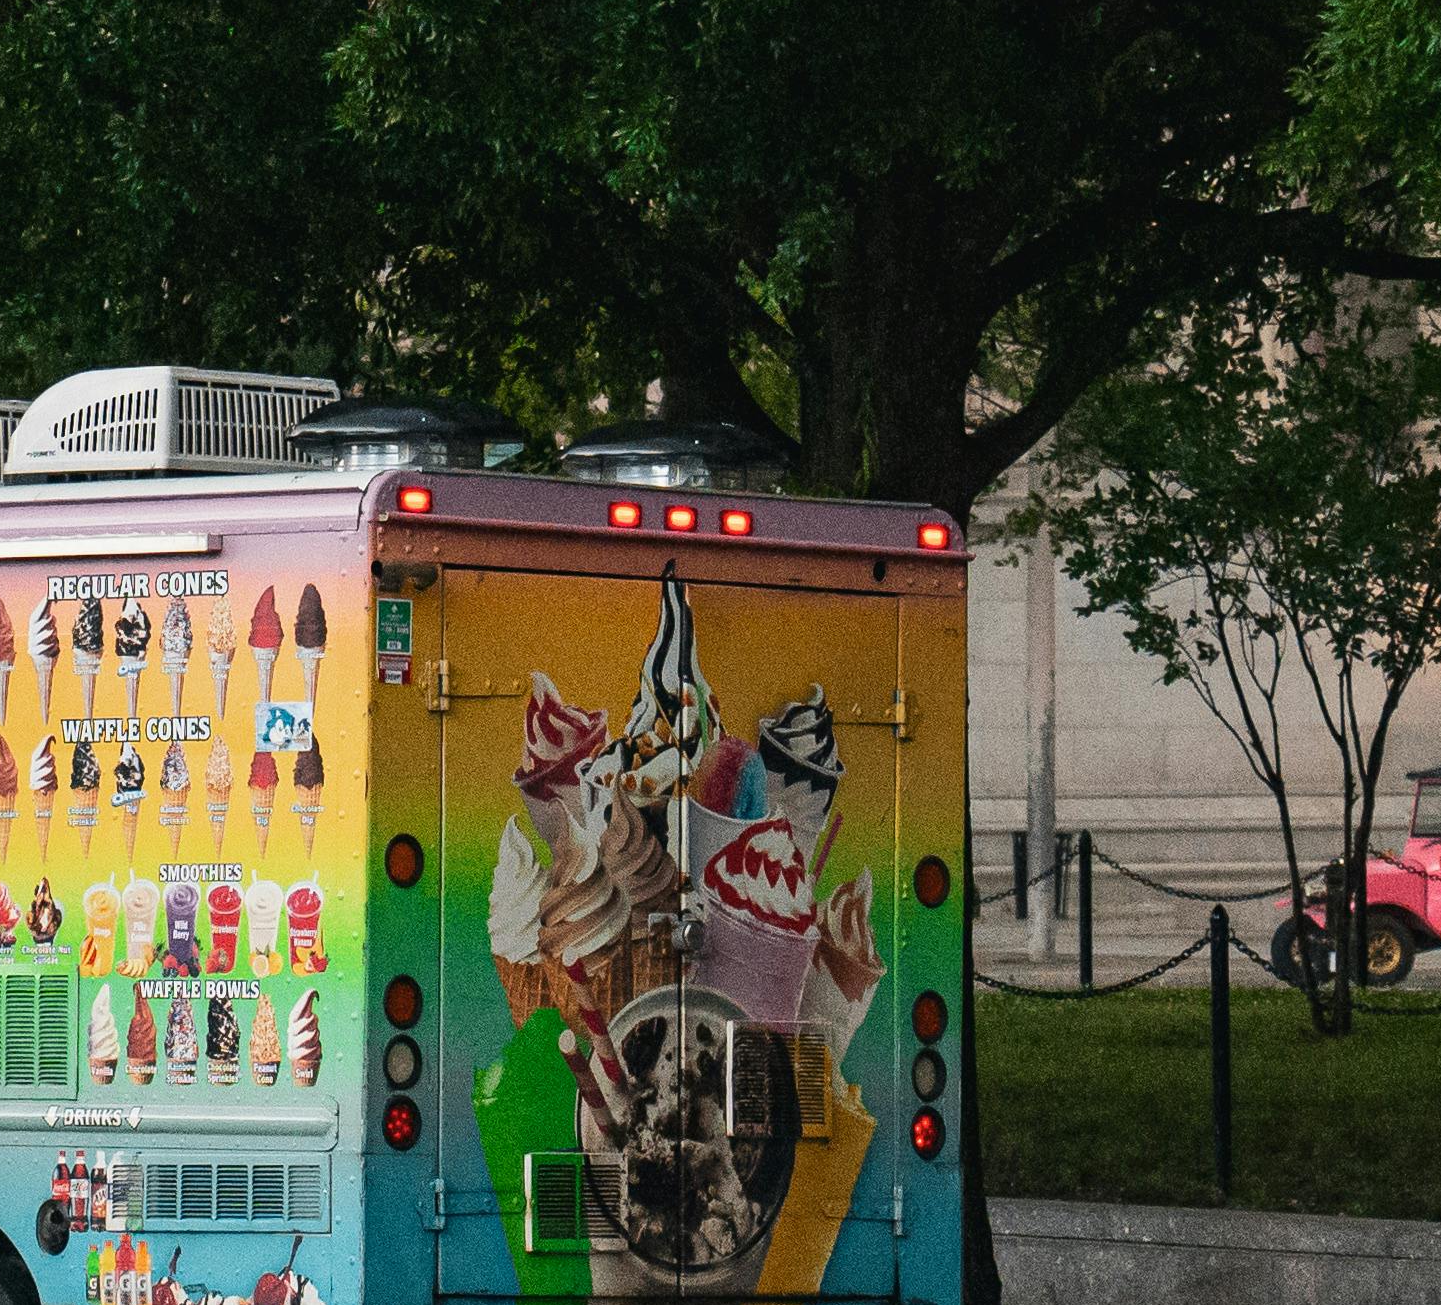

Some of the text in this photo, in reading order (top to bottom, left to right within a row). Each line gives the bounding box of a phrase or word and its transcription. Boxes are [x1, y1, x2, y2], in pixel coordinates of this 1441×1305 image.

[47, 570, 229, 600] REGULAR CONES
[61, 716, 212, 743] WAFFLE CONES
[290, 803, 326, 813] Chocolate
[256, 816, 268, 826] Dip
[301, 815, 315, 825] Dip
[159, 863, 243, 882] SMOOTHIES
[174, 920, 189, 930] Wild
[172, 929, 190, 941] Berry
[22, 945, 71, 954] Chocolate Nut
[139, 979, 260, 999] WAFFLE BOWLS
[90, 1065, 114, 1077] Vanilla
[124, 1063, 157, 1074] Chocolate
[206, 1062, 240, 1073] Chocolate
[253, 1063, 277, 1074] Peanut
[294, 1067, 314, 1080] Swirl
[166, 1072, 198, 1085] Sprinkles
[207, 1073, 240, 1085] Sprinkles
[256, 1074, 274, 1085] Cone
[63, 1107, 122, 1127] DRINKS
